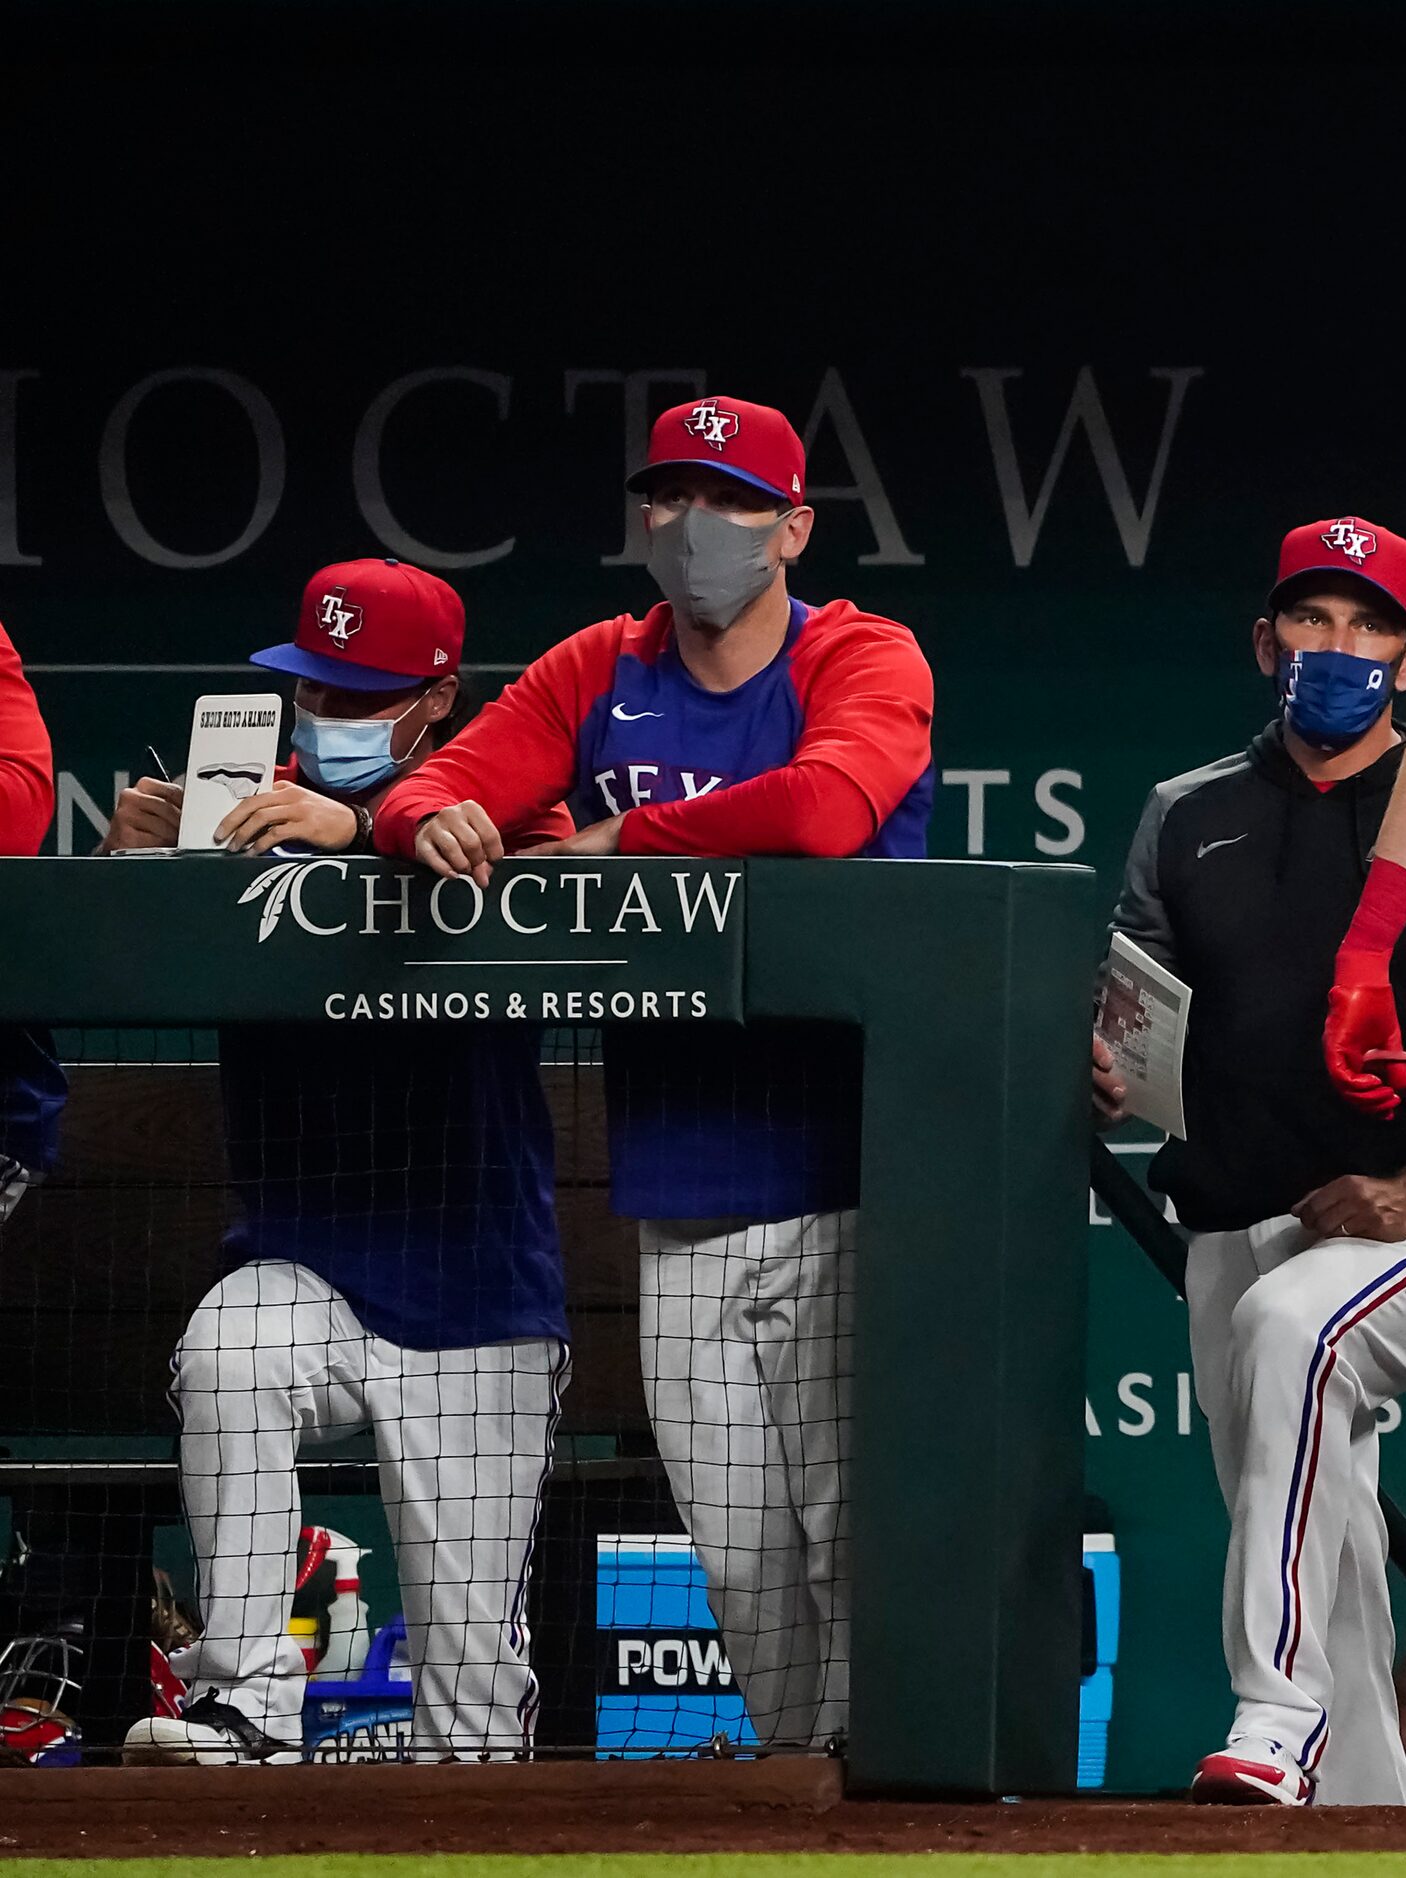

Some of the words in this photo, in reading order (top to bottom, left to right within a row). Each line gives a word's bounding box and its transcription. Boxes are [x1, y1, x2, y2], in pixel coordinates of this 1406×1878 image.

[0, 364, 1205, 570] OCTAW
[289, 859, 741, 936] CHOCTAW
[325, 992, 490, 1020] CASINOS
[505, 992, 527, 1019] &
[542, 990, 707, 1019] RESORTS
